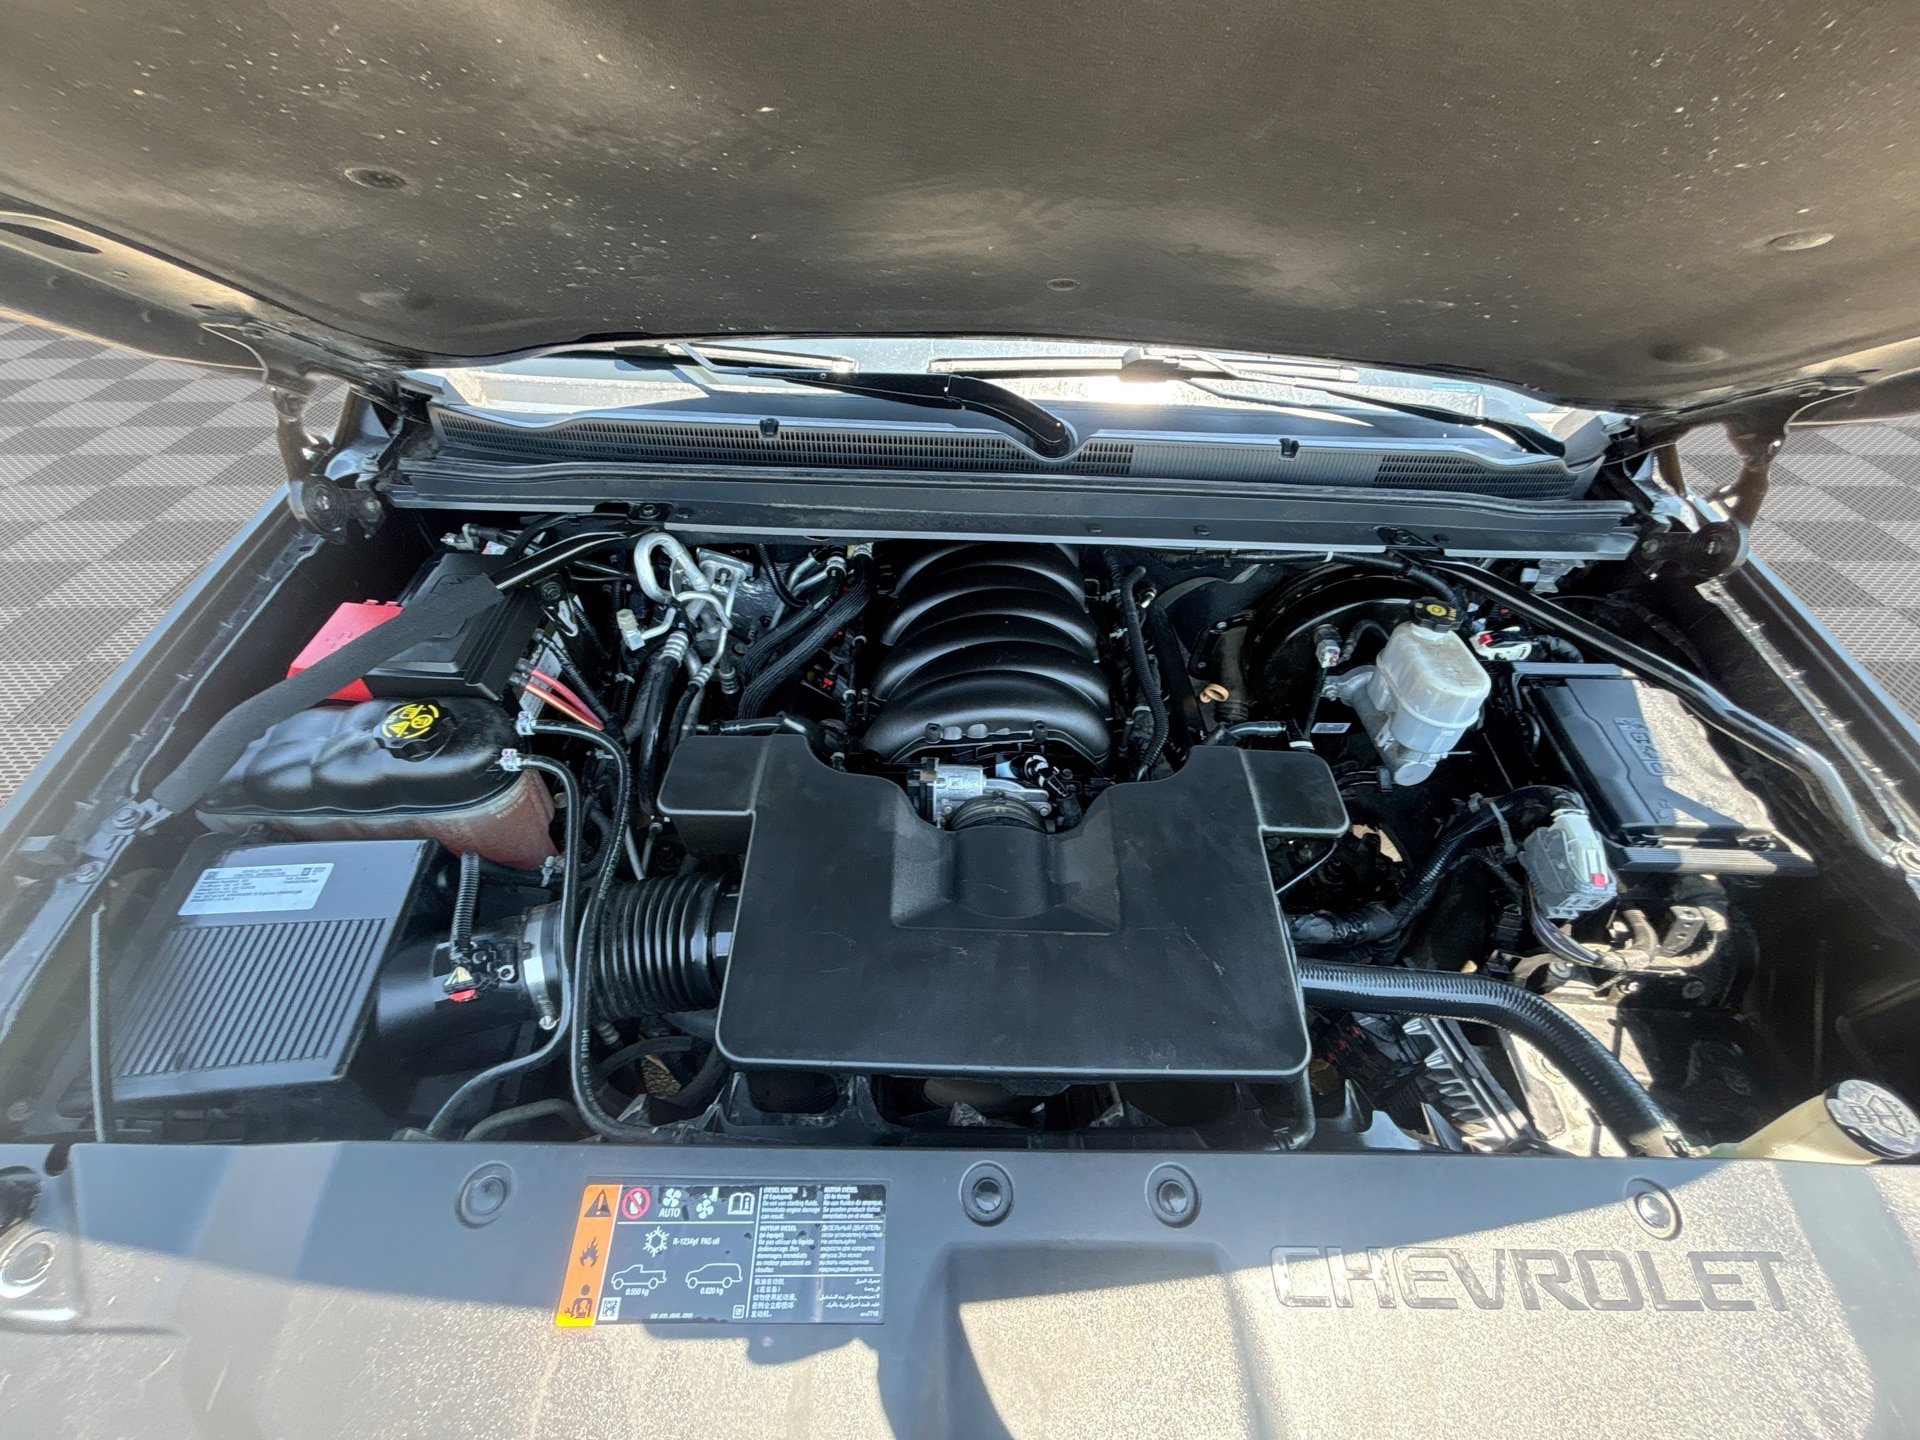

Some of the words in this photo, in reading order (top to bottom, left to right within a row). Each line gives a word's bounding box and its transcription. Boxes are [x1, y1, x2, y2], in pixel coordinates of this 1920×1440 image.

[658, 1208, 681, 1218] AUTO
[1270, 1244, 1788, 1311] CHEVROLET
[641, 1288, 650, 1296] kg
[716, 1287, 725, 1295] kg
